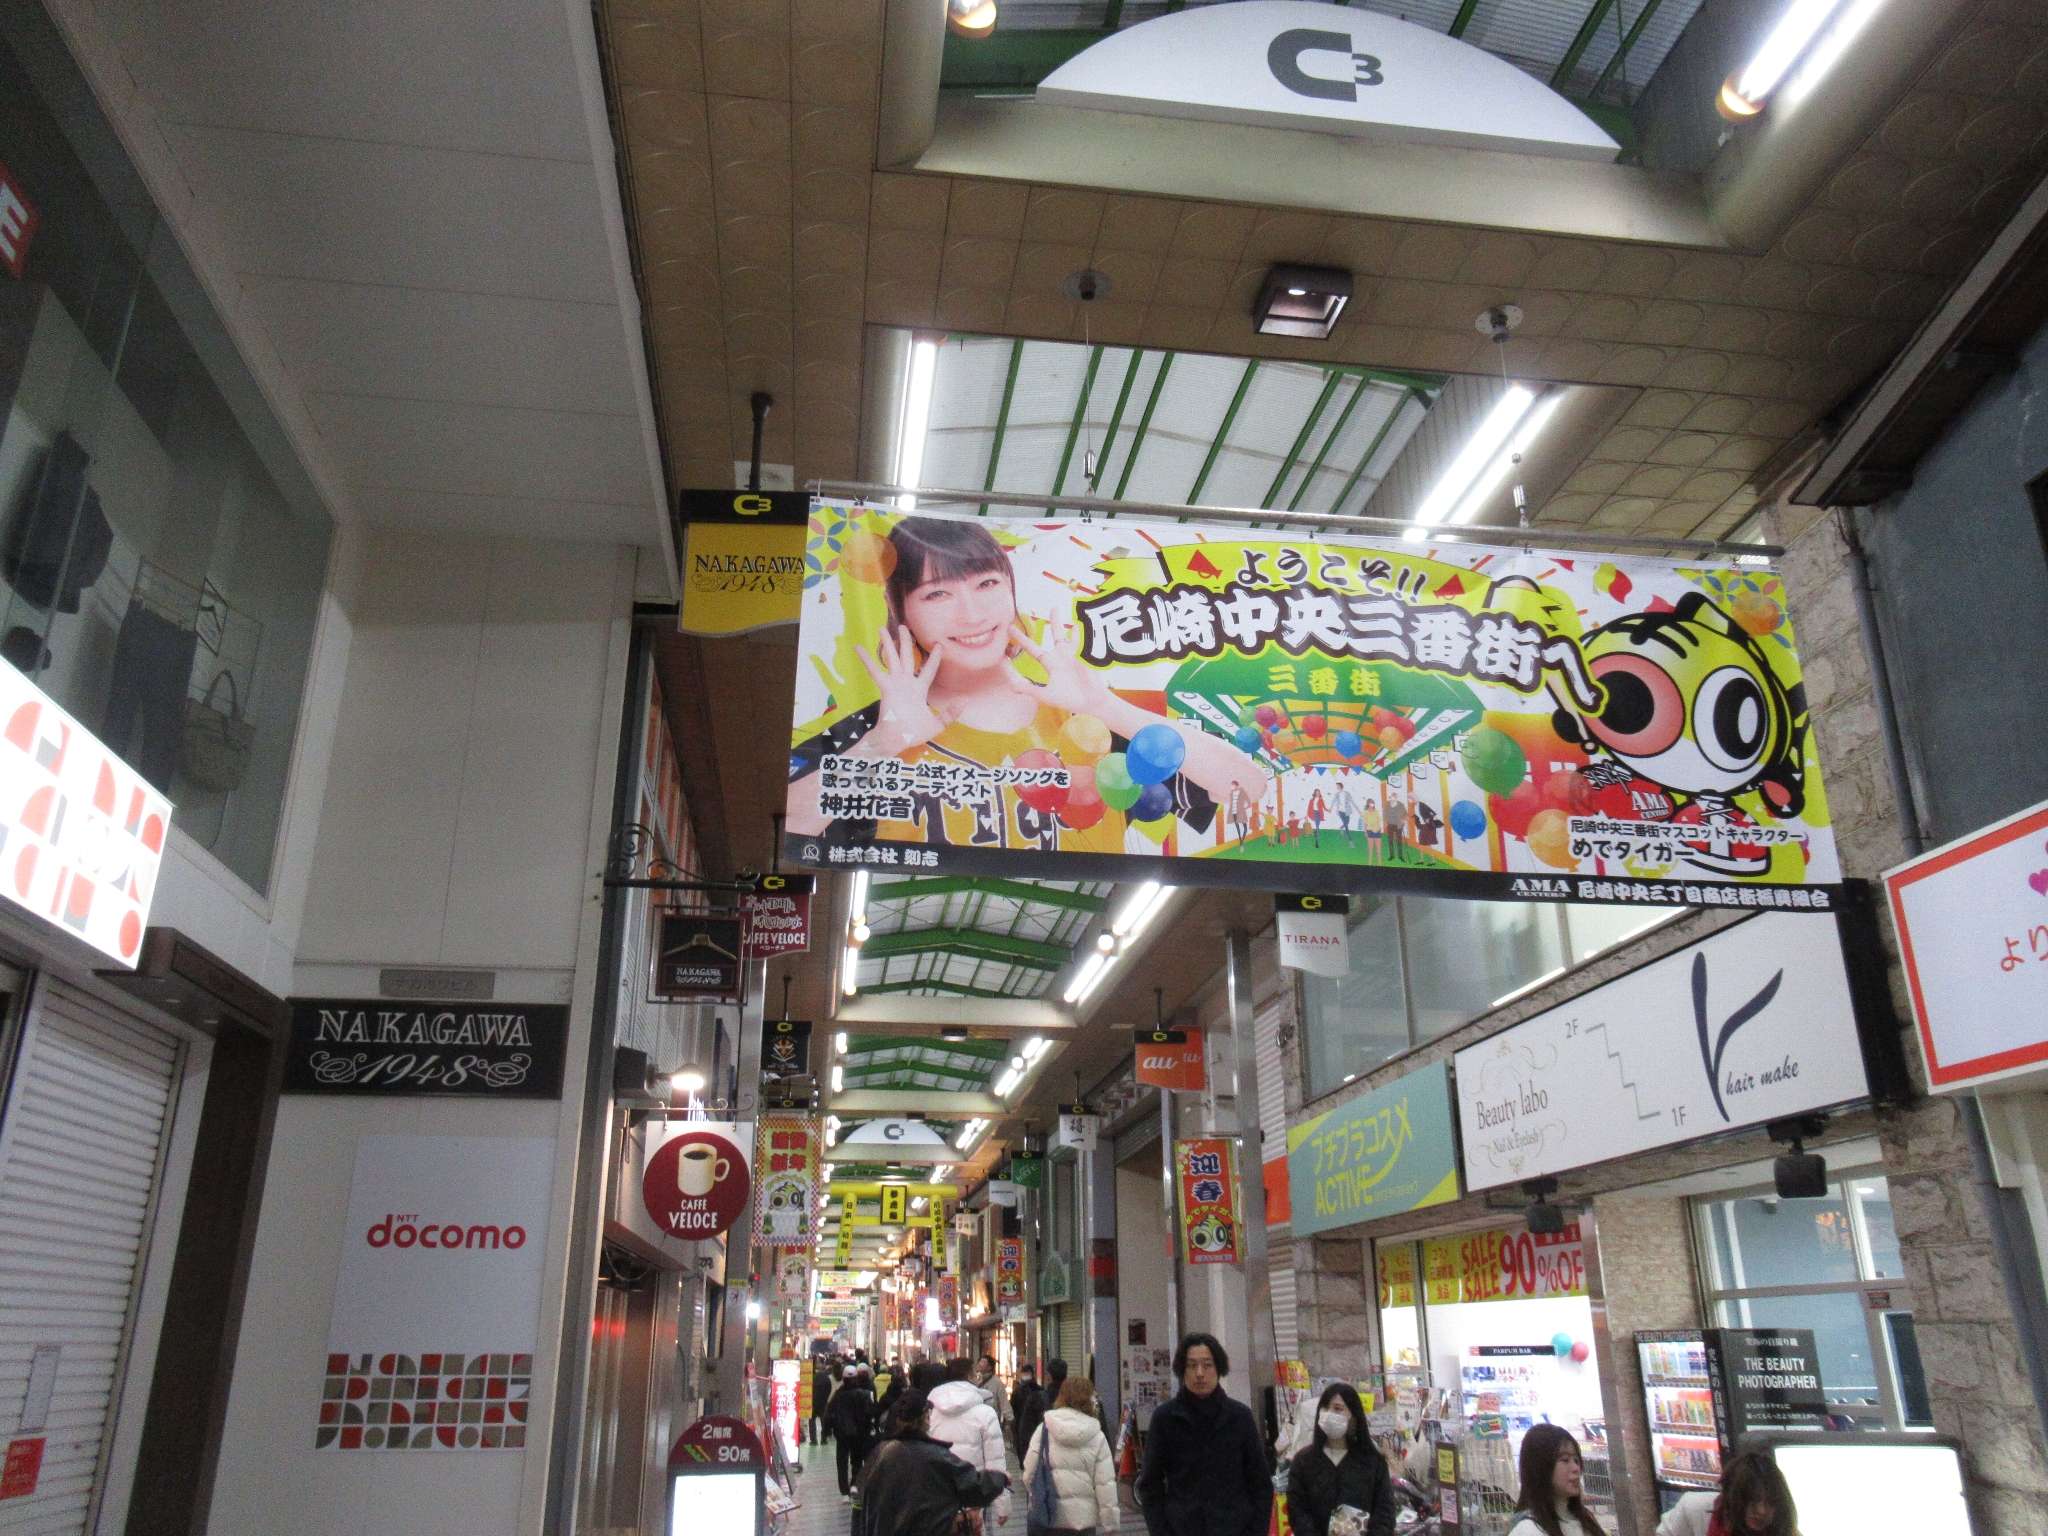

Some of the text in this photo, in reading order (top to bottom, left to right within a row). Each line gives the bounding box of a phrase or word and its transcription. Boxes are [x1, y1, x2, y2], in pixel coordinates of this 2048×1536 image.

[695, 554, 805, 575] NAKAGAWA
[1238, 548, 1426, 603] ようこそ!!
[1083, 587, 1598, 706] 尼崎中央三番街へ
[1267, 664, 1382, 698] 三番街
[822, 756, 1069, 787] めでタイガー公式イメージソングを
[822, 772, 992, 797] 歌っているアーティスト
[1570, 819, 1803, 843] 尼崎中央三番街マスコットキャラクター
[829, 846, 898, 865] 株式会社
[1572, 838, 1695, 863] めでタイガー
[1511, 878, 1573, 892] AMA
[770, 932, 806, 945] VELOCE
[1284, 934, 1340, 945] TIRANA
[314, 1009, 532, 1047] NAKAGAWA
[1565, 1019, 1579, 1038] 2F
[359, 1053, 478, 1087] 1948
[1142, 1056, 1179, 1070] au
[1726, 1053, 1800, 1096] hair make
[1475, 1079, 1549, 1132] Beauty labo
[1671, 1106, 1687, 1128] 1F
[1190, 1153, 1223, 1202] 迎春
[681, 1199, 708, 1211] CAFFE
[396, 1214, 420, 1223] NTT
[669, 1211, 718, 1229] VELOCE
[366, 1213, 527, 1249] docomo
[1461, 1231, 1498, 1274] SALE
[1464, 1263, 1501, 1303] SALE
[1744, 1357, 1805, 1372] THE BEAUTY
[1738, 1375, 1818, 1390] PHOTOGRAPHER
[702, 1423, 733, 1440] 2階席
[717, 1445, 751, 1462] 90席
